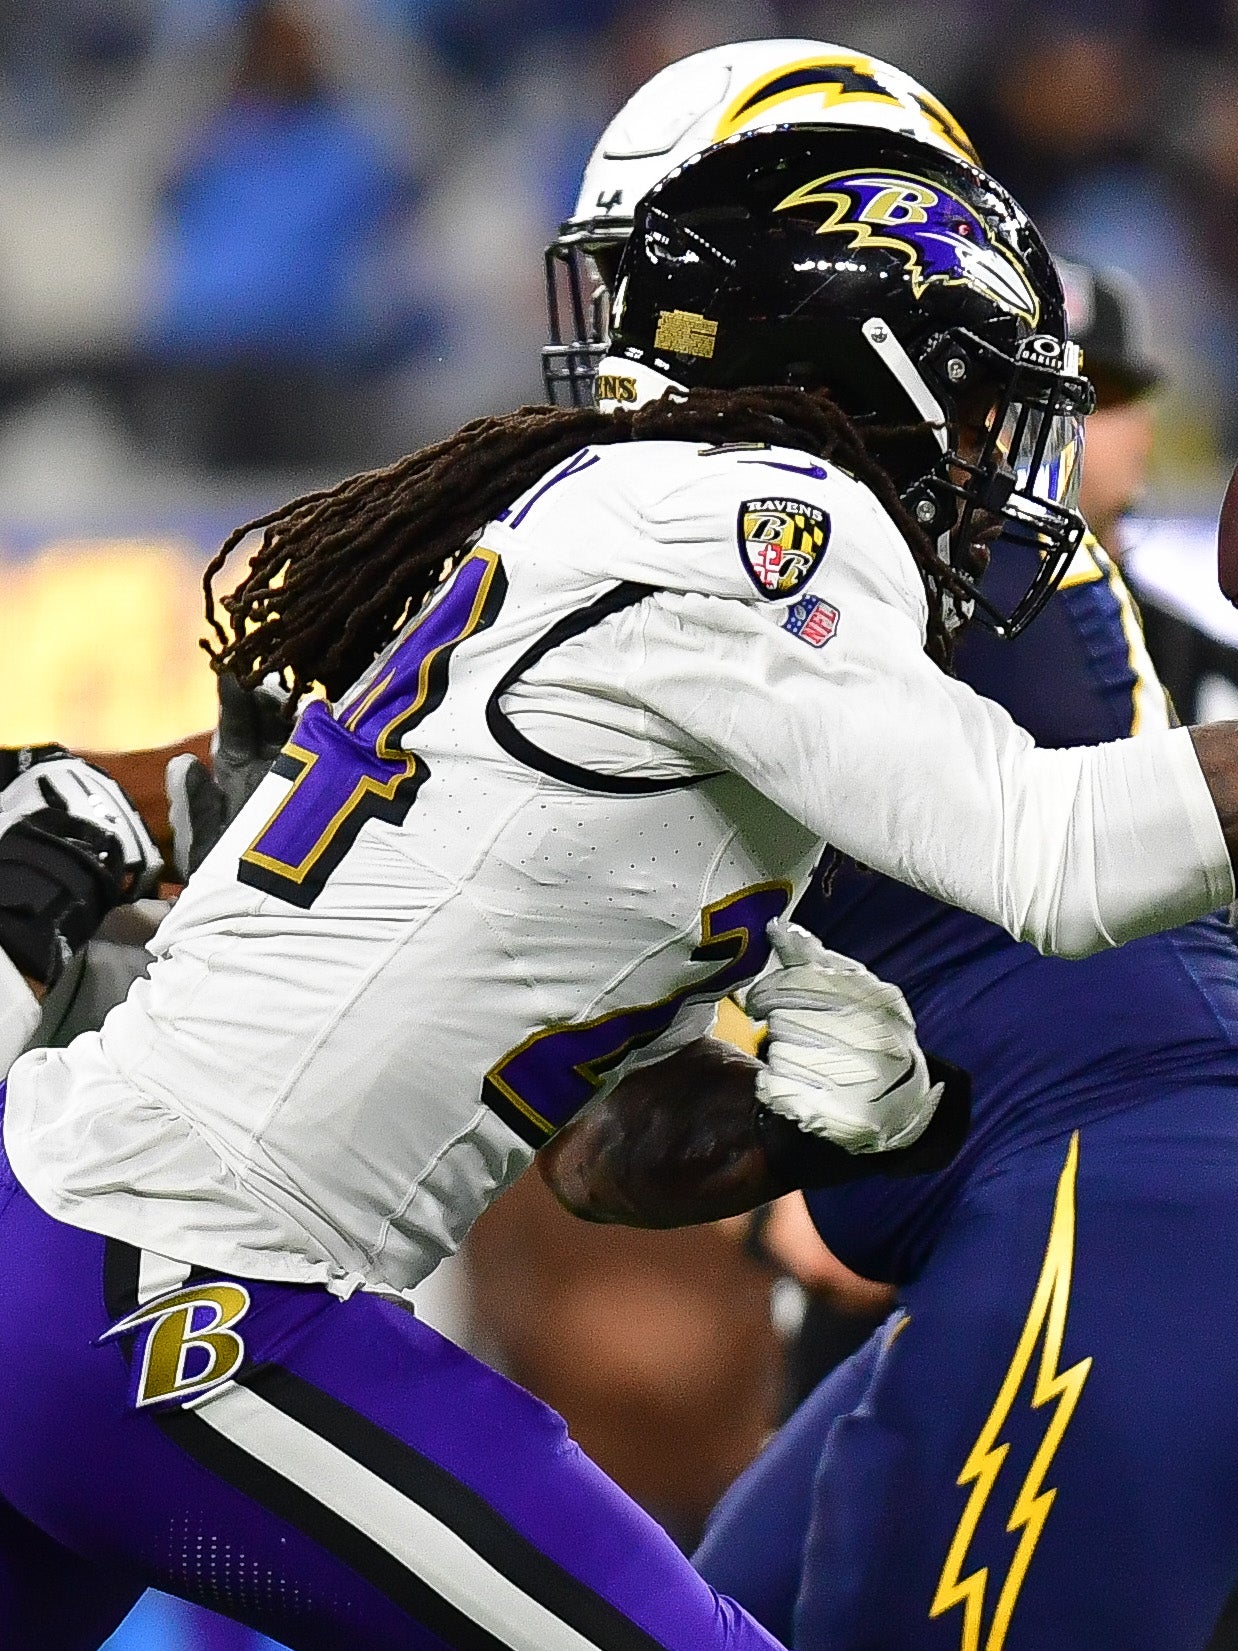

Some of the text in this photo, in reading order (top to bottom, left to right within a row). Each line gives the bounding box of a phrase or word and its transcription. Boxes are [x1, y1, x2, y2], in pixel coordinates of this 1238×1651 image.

[746, 500, 824, 522] RAVENS
[746, 512, 789, 543] B
[800, 606, 838, 645] NFL
[98, 1281, 251, 1408] B
